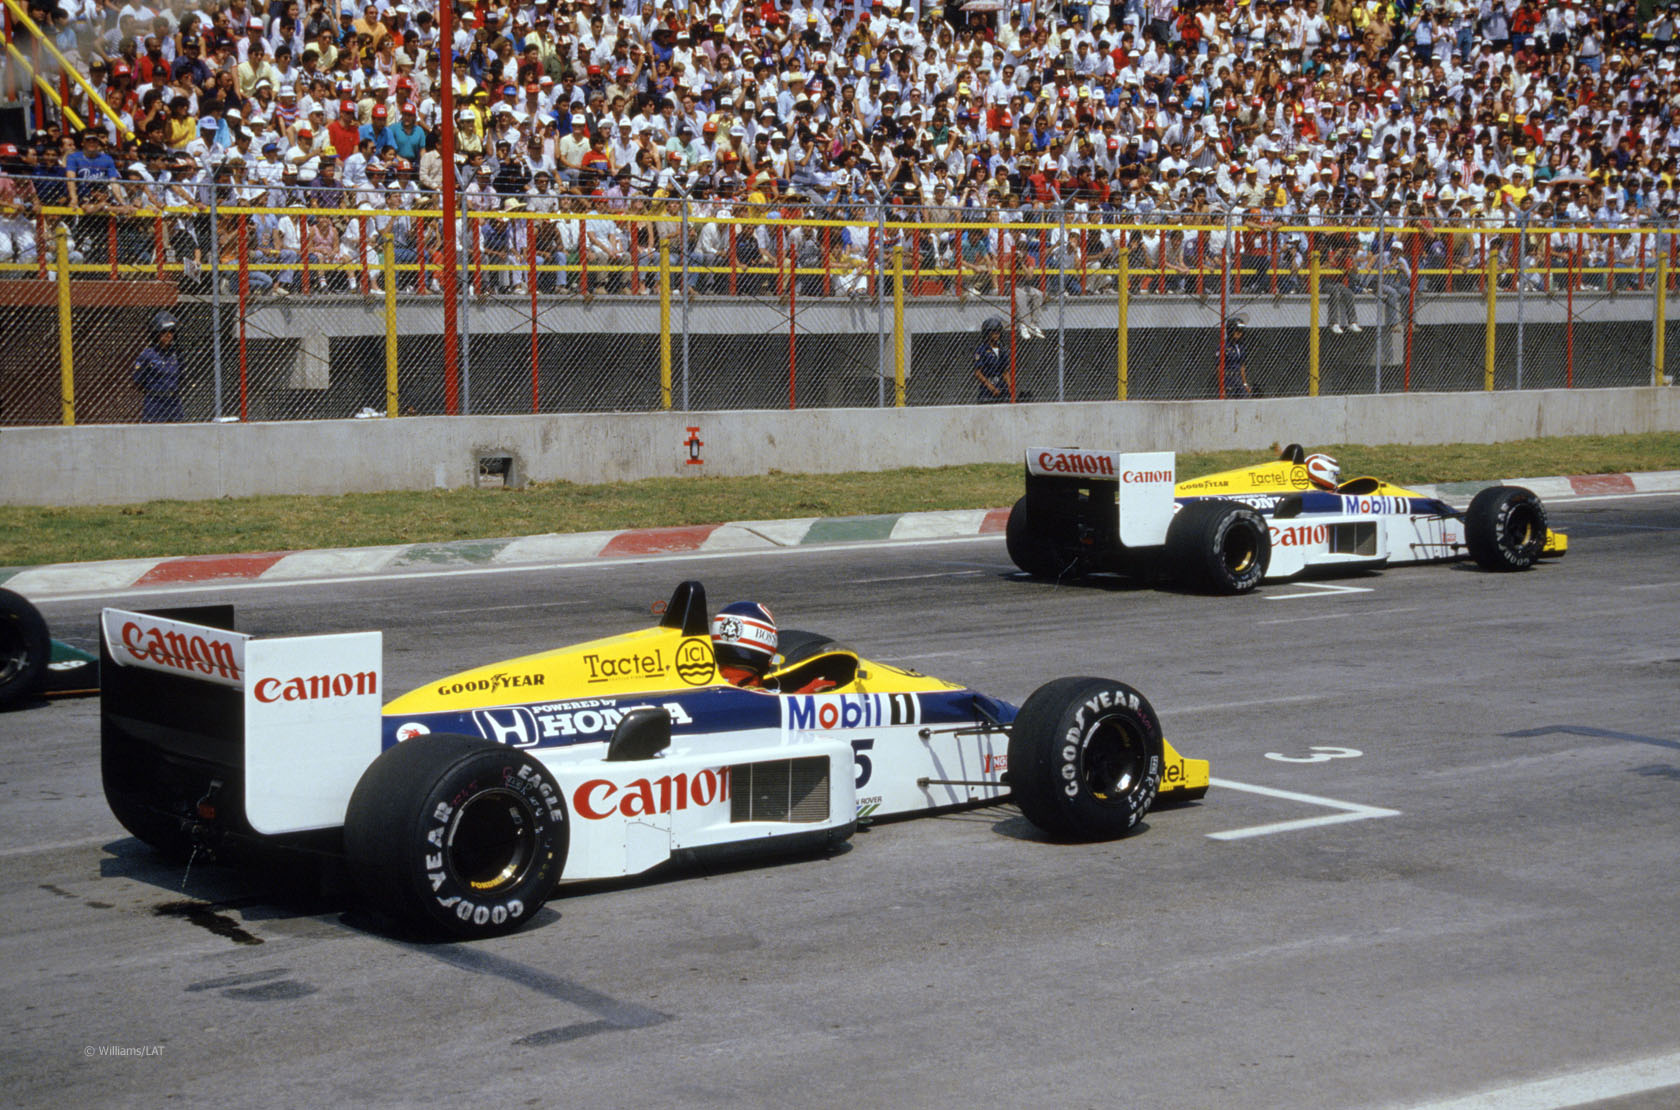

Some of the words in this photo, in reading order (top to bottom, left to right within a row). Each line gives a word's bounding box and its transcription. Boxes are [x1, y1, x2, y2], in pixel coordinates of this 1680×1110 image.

[1038, 452, 1114, 475] Canon
[1122, 470, 1172, 484] Canon
[1347, 496, 1391, 514] Mobil
[121, 621, 241, 681] Canon
[583, 649, 664, 678] Tactel
[685, 647, 706, 662] ICI
[254, 671, 377, 704] Canon
[531, 700, 600, 714] POWERED
[600, 698, 617, 707] by
[787, 694, 881, 731] Mobil
[894, 694, 907, 724] 1
[538, 702, 693, 737] HONA
[518, 763, 563, 822] EAGLE
[861, 795, 882, 805] ROVER
